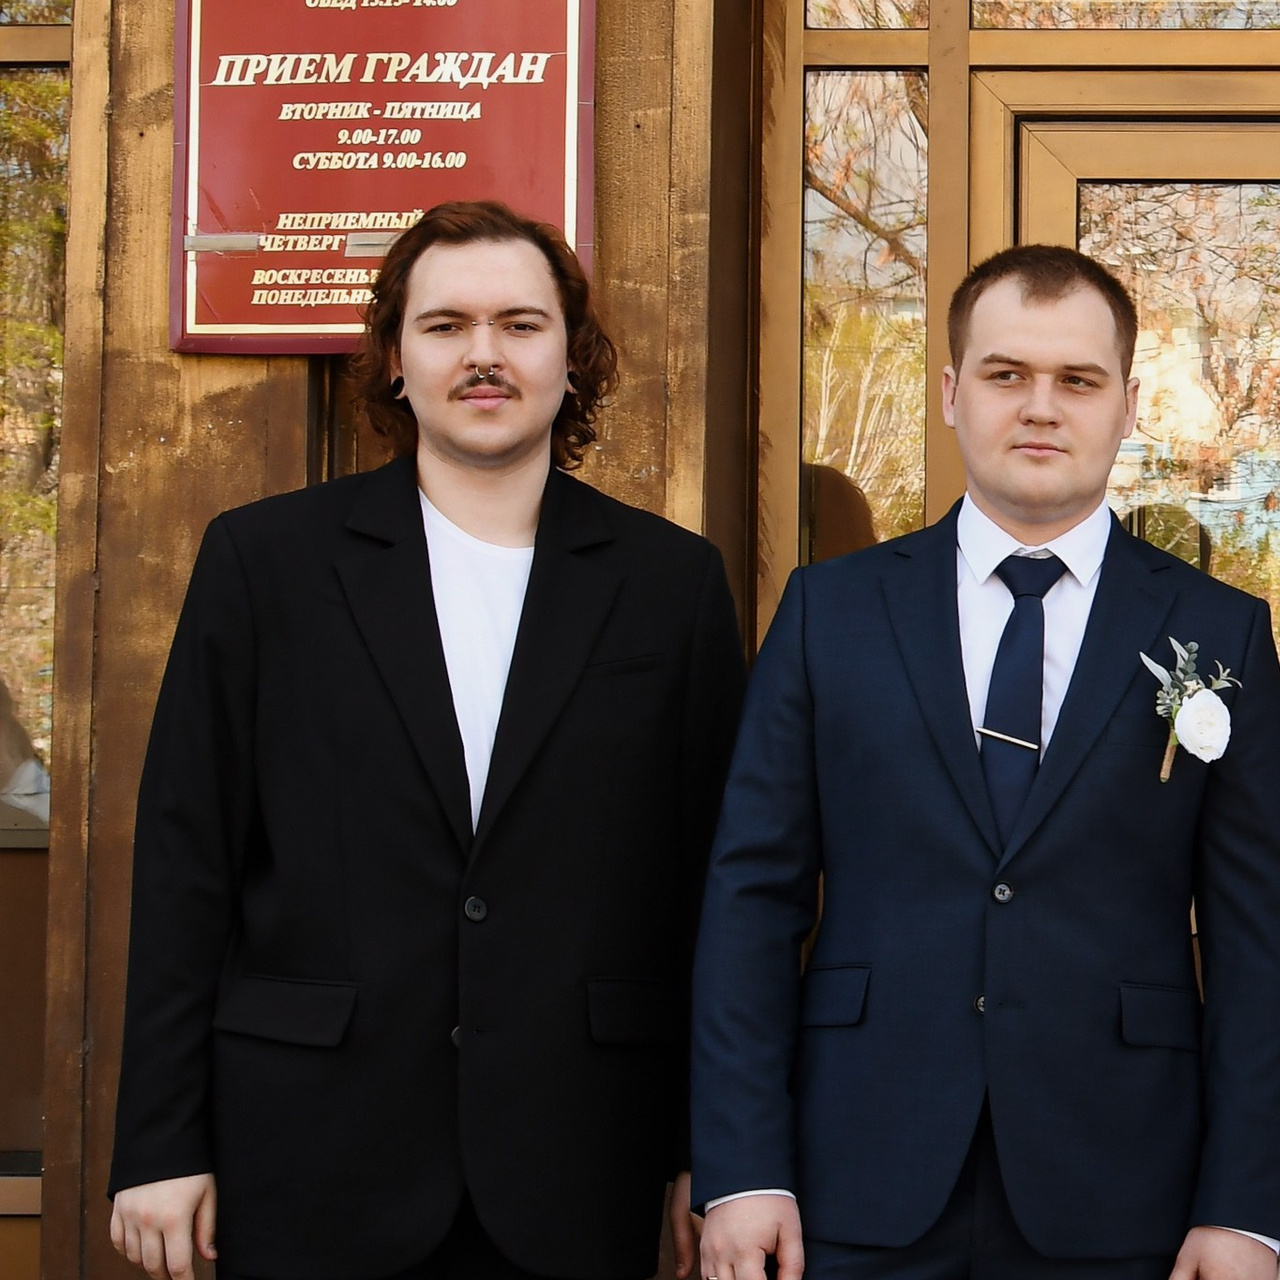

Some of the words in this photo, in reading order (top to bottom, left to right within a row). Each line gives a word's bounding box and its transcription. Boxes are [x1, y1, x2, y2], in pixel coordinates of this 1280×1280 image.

[211, 53, 358, 86] ПРИЕМ
[358, 52, 551, 90] ГРАЖДАН
[278, 101, 371, 120] ВТОРНИК
[382, 101, 482, 122] ПЯТНИЦА
[337, 128, 422, 145] 9.00-17.00
[292, 152, 379, 170] СУББОТА
[382, 151, 467, 169] 9.00-16.00
[258, 234, 346, 253] ЧЕТВЕРГ
